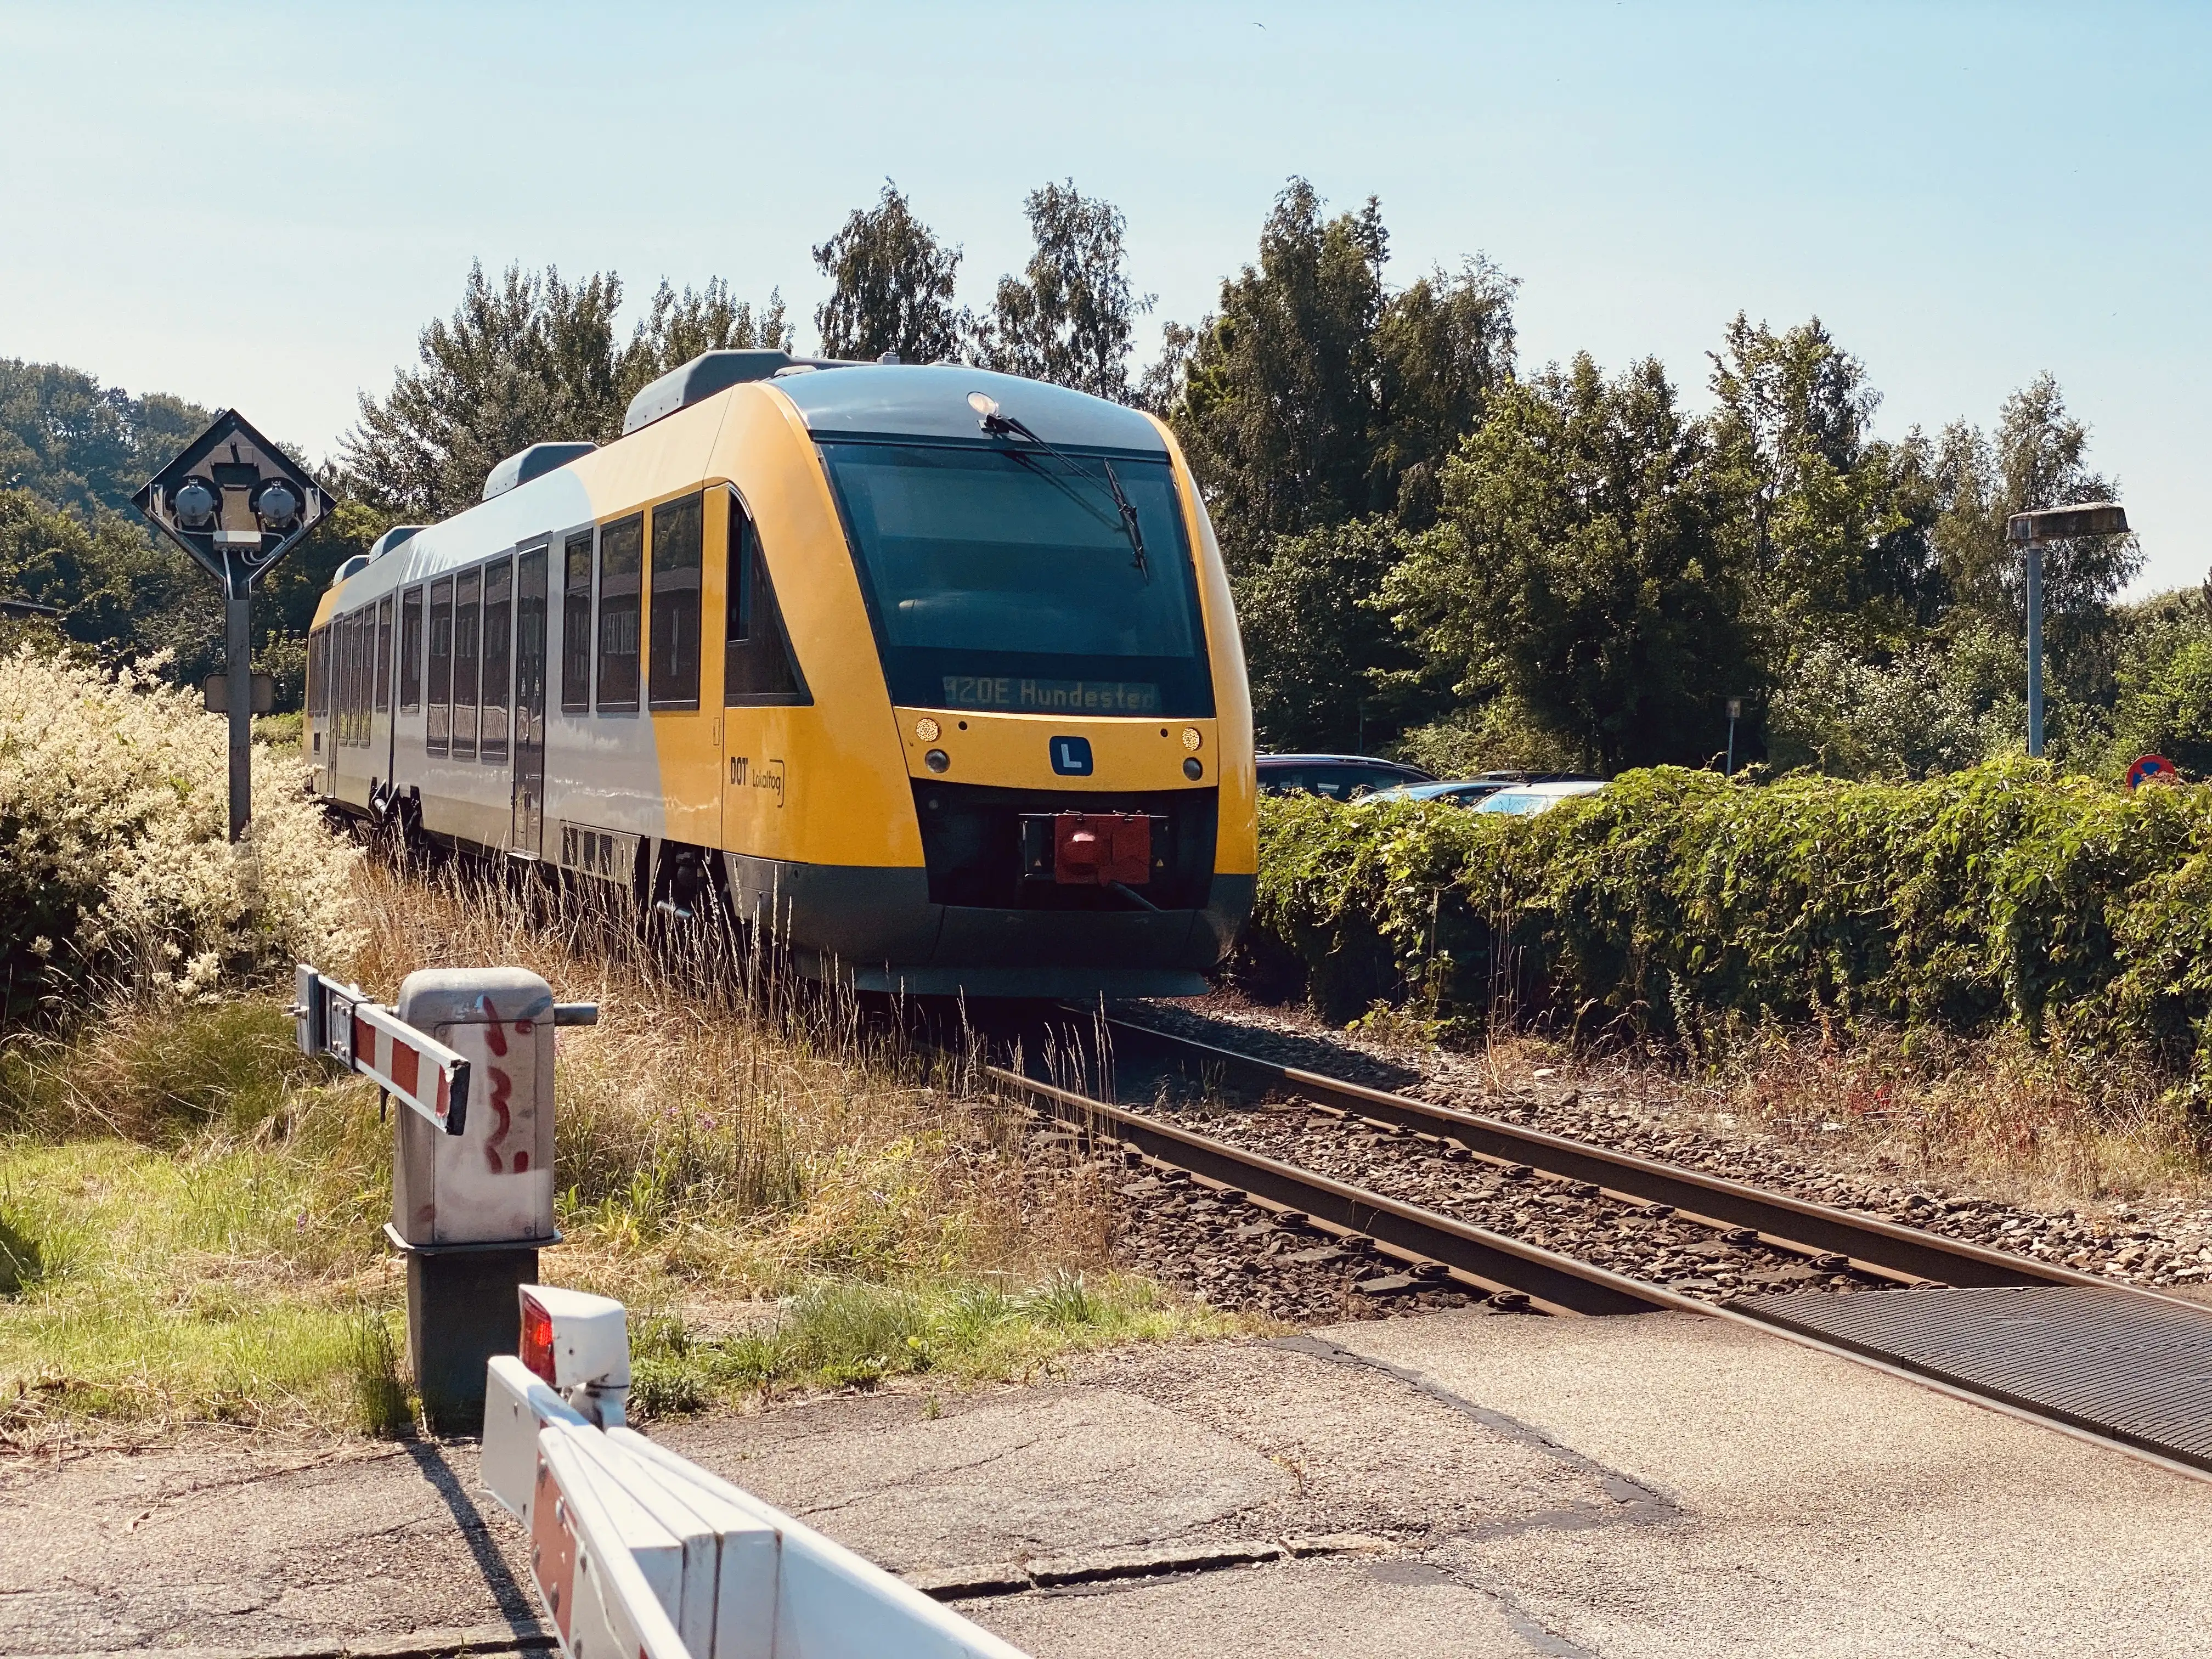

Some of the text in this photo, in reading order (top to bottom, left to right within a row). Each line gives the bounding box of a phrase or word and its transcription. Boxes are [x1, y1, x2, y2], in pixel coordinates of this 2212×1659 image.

[1061, 744, 1082, 768] L
[731, 757, 780, 796] DOT Lokaltog
